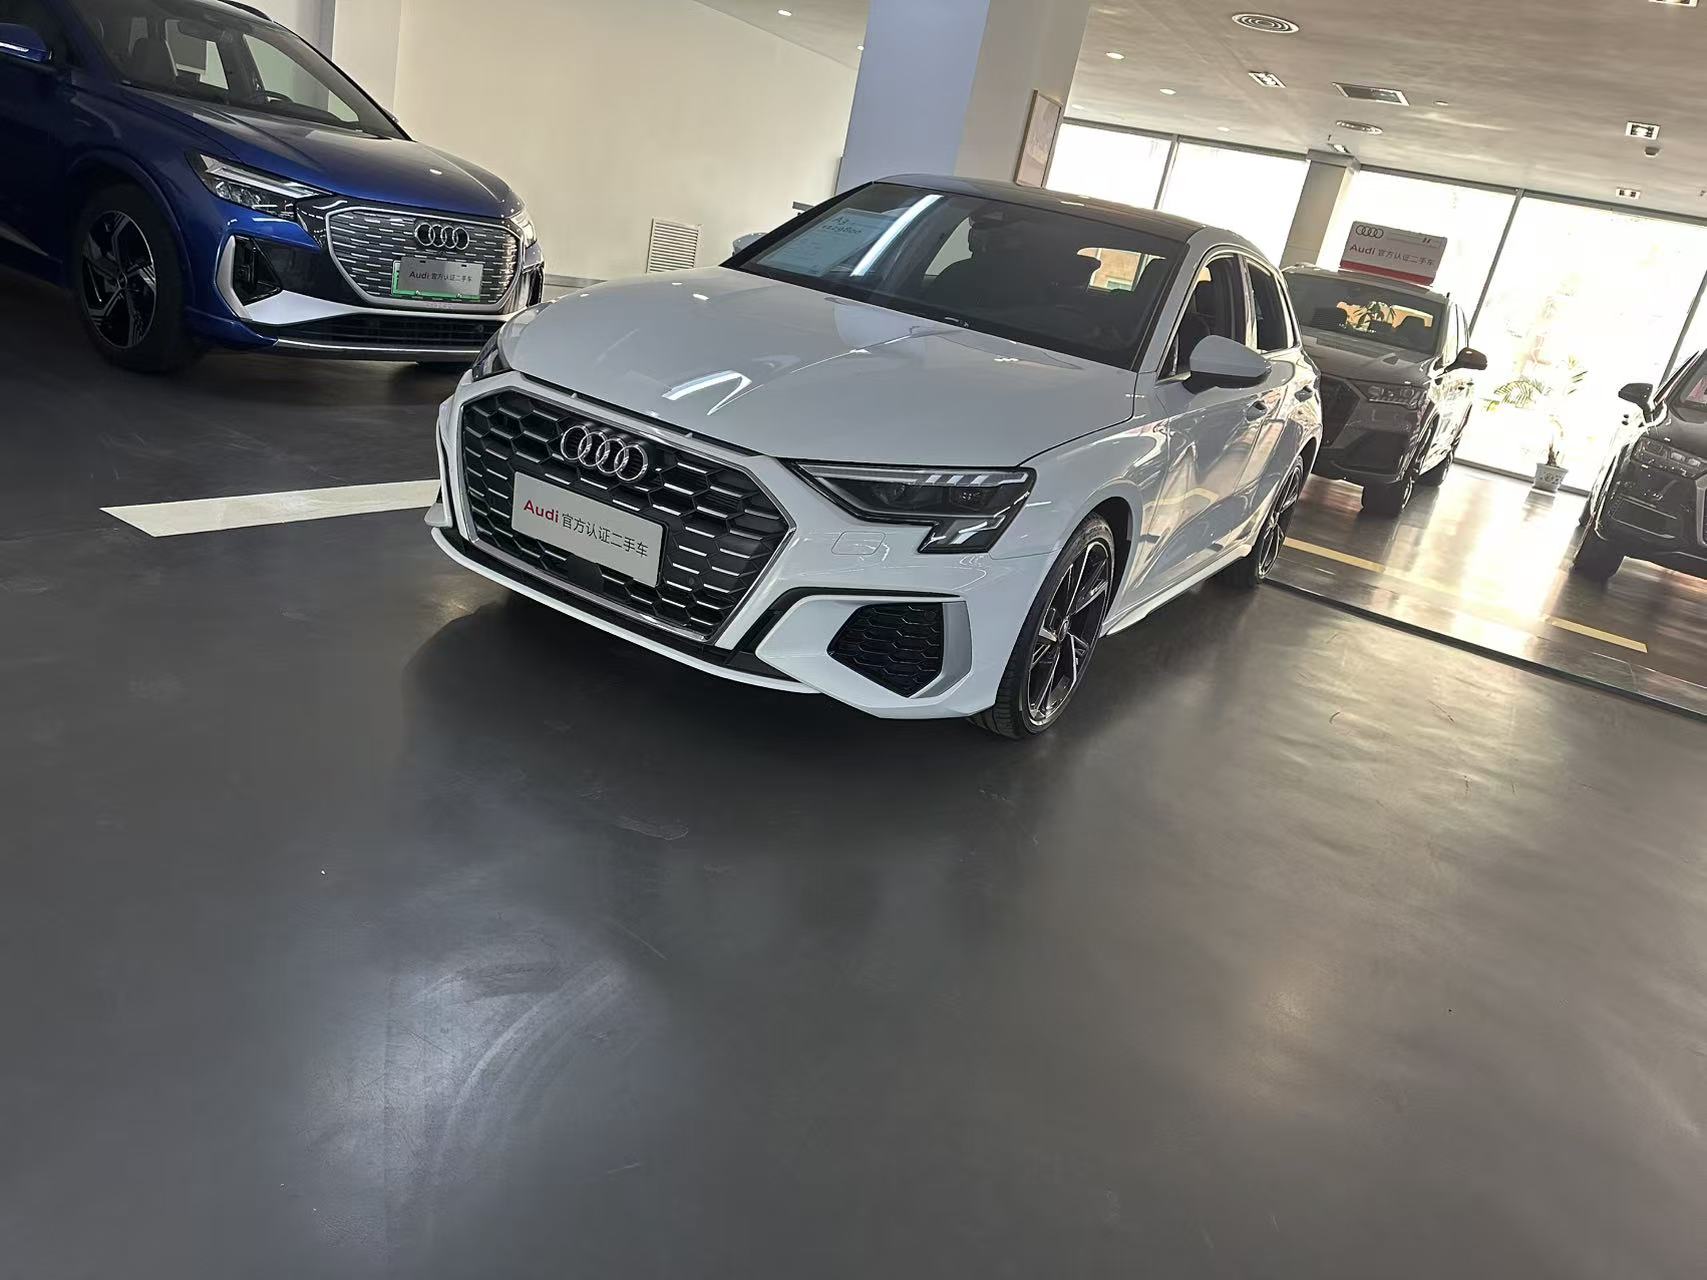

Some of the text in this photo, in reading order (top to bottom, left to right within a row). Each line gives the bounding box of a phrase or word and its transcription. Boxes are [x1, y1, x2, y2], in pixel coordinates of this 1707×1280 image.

[1349, 243, 1435, 266] Audi 官方认证二手车
[408, 271, 473, 282] Audi 官方认证二手车
[523, 499, 649, 558] Audi 官方认证二手车
